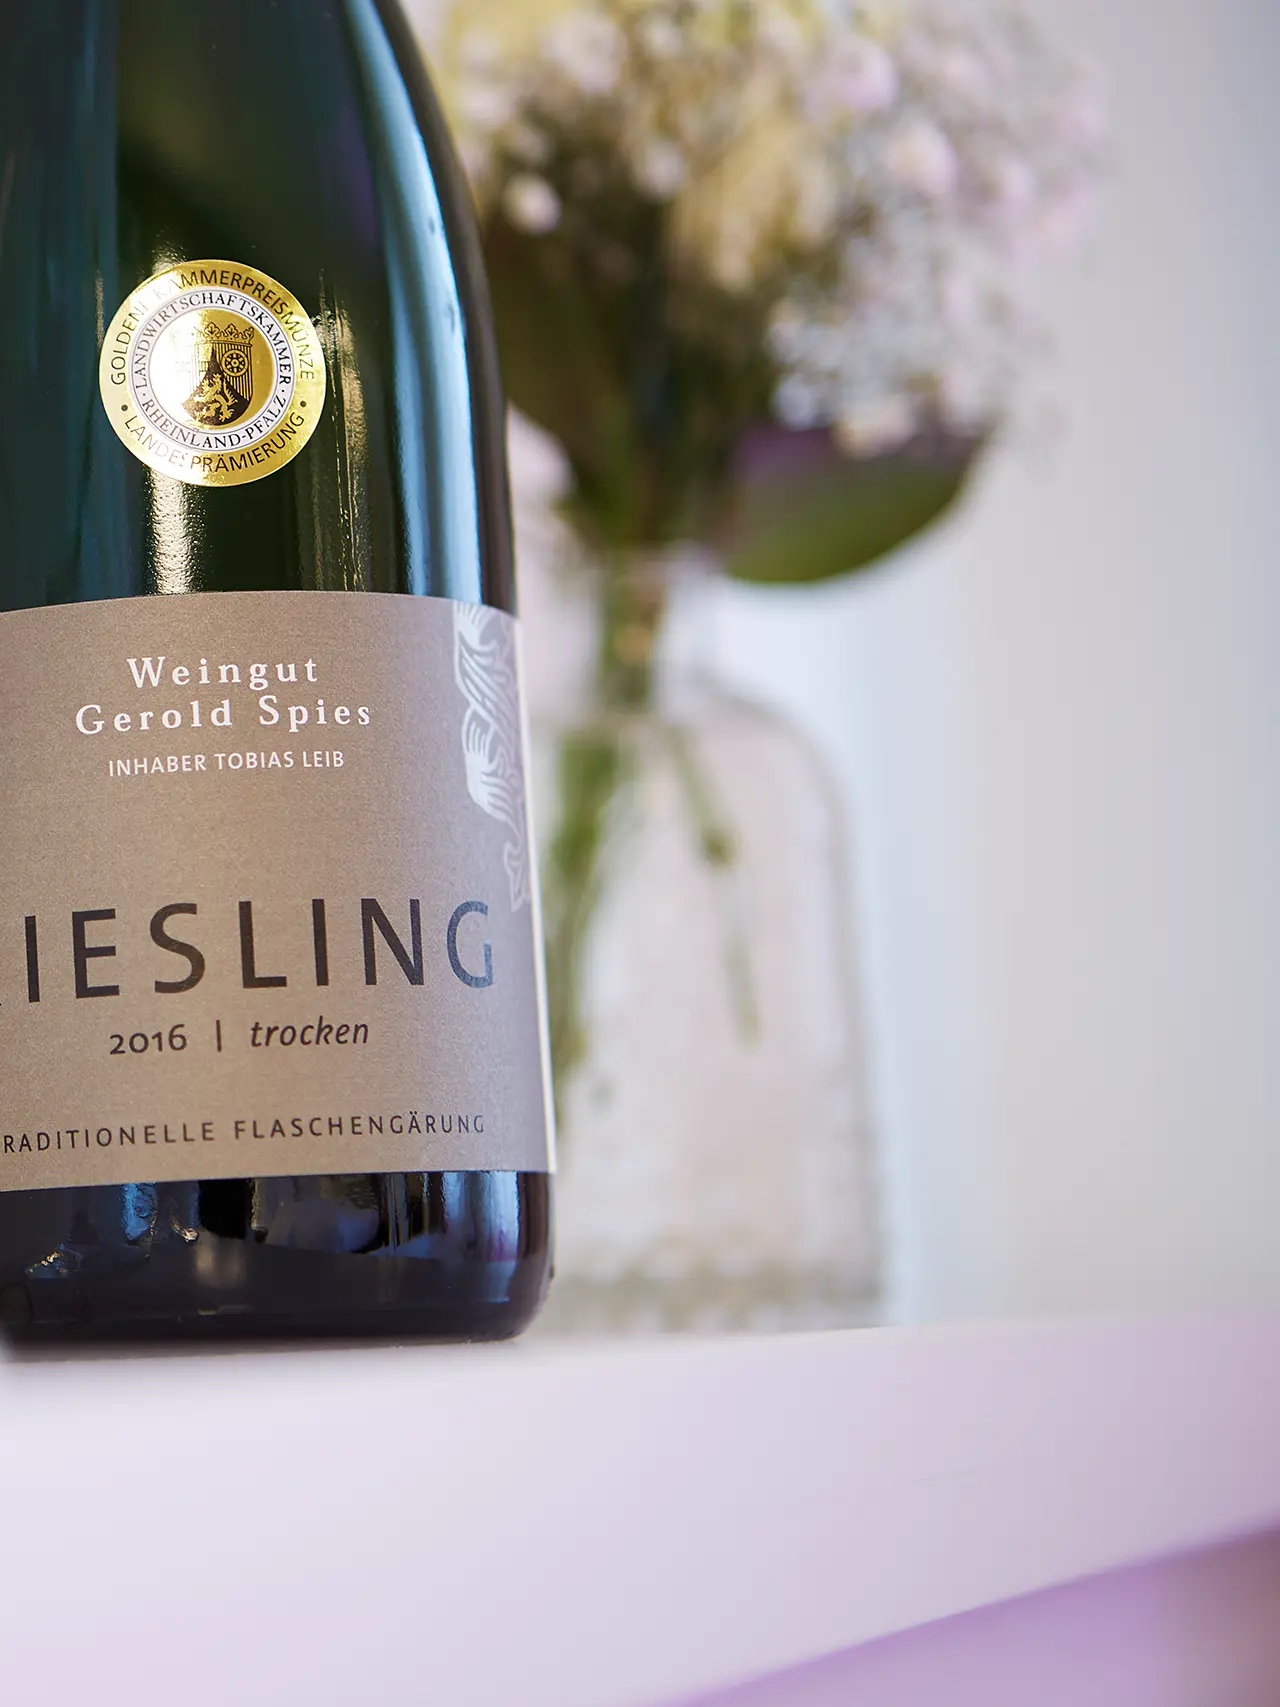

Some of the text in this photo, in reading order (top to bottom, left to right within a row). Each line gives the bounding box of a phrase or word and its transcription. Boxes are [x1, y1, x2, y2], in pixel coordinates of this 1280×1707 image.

[110, 302, 148, 386] GOLDEN
[135, 291, 292, 388] LANDWIRTSCHAFTSKAMMER
[142, 395, 286, 449] RHEINLAND-PFALZ
[126, 656, 319, 690] Weingut
[75, 695, 371, 735] Gerold Spies
[108, 750, 345, 777] INHABER TOBIAS LEIB
[109, 1016, 370, 1056] 2016 trocken
[234, 1111, 486, 1140] FLASCHENGÄRUNG
